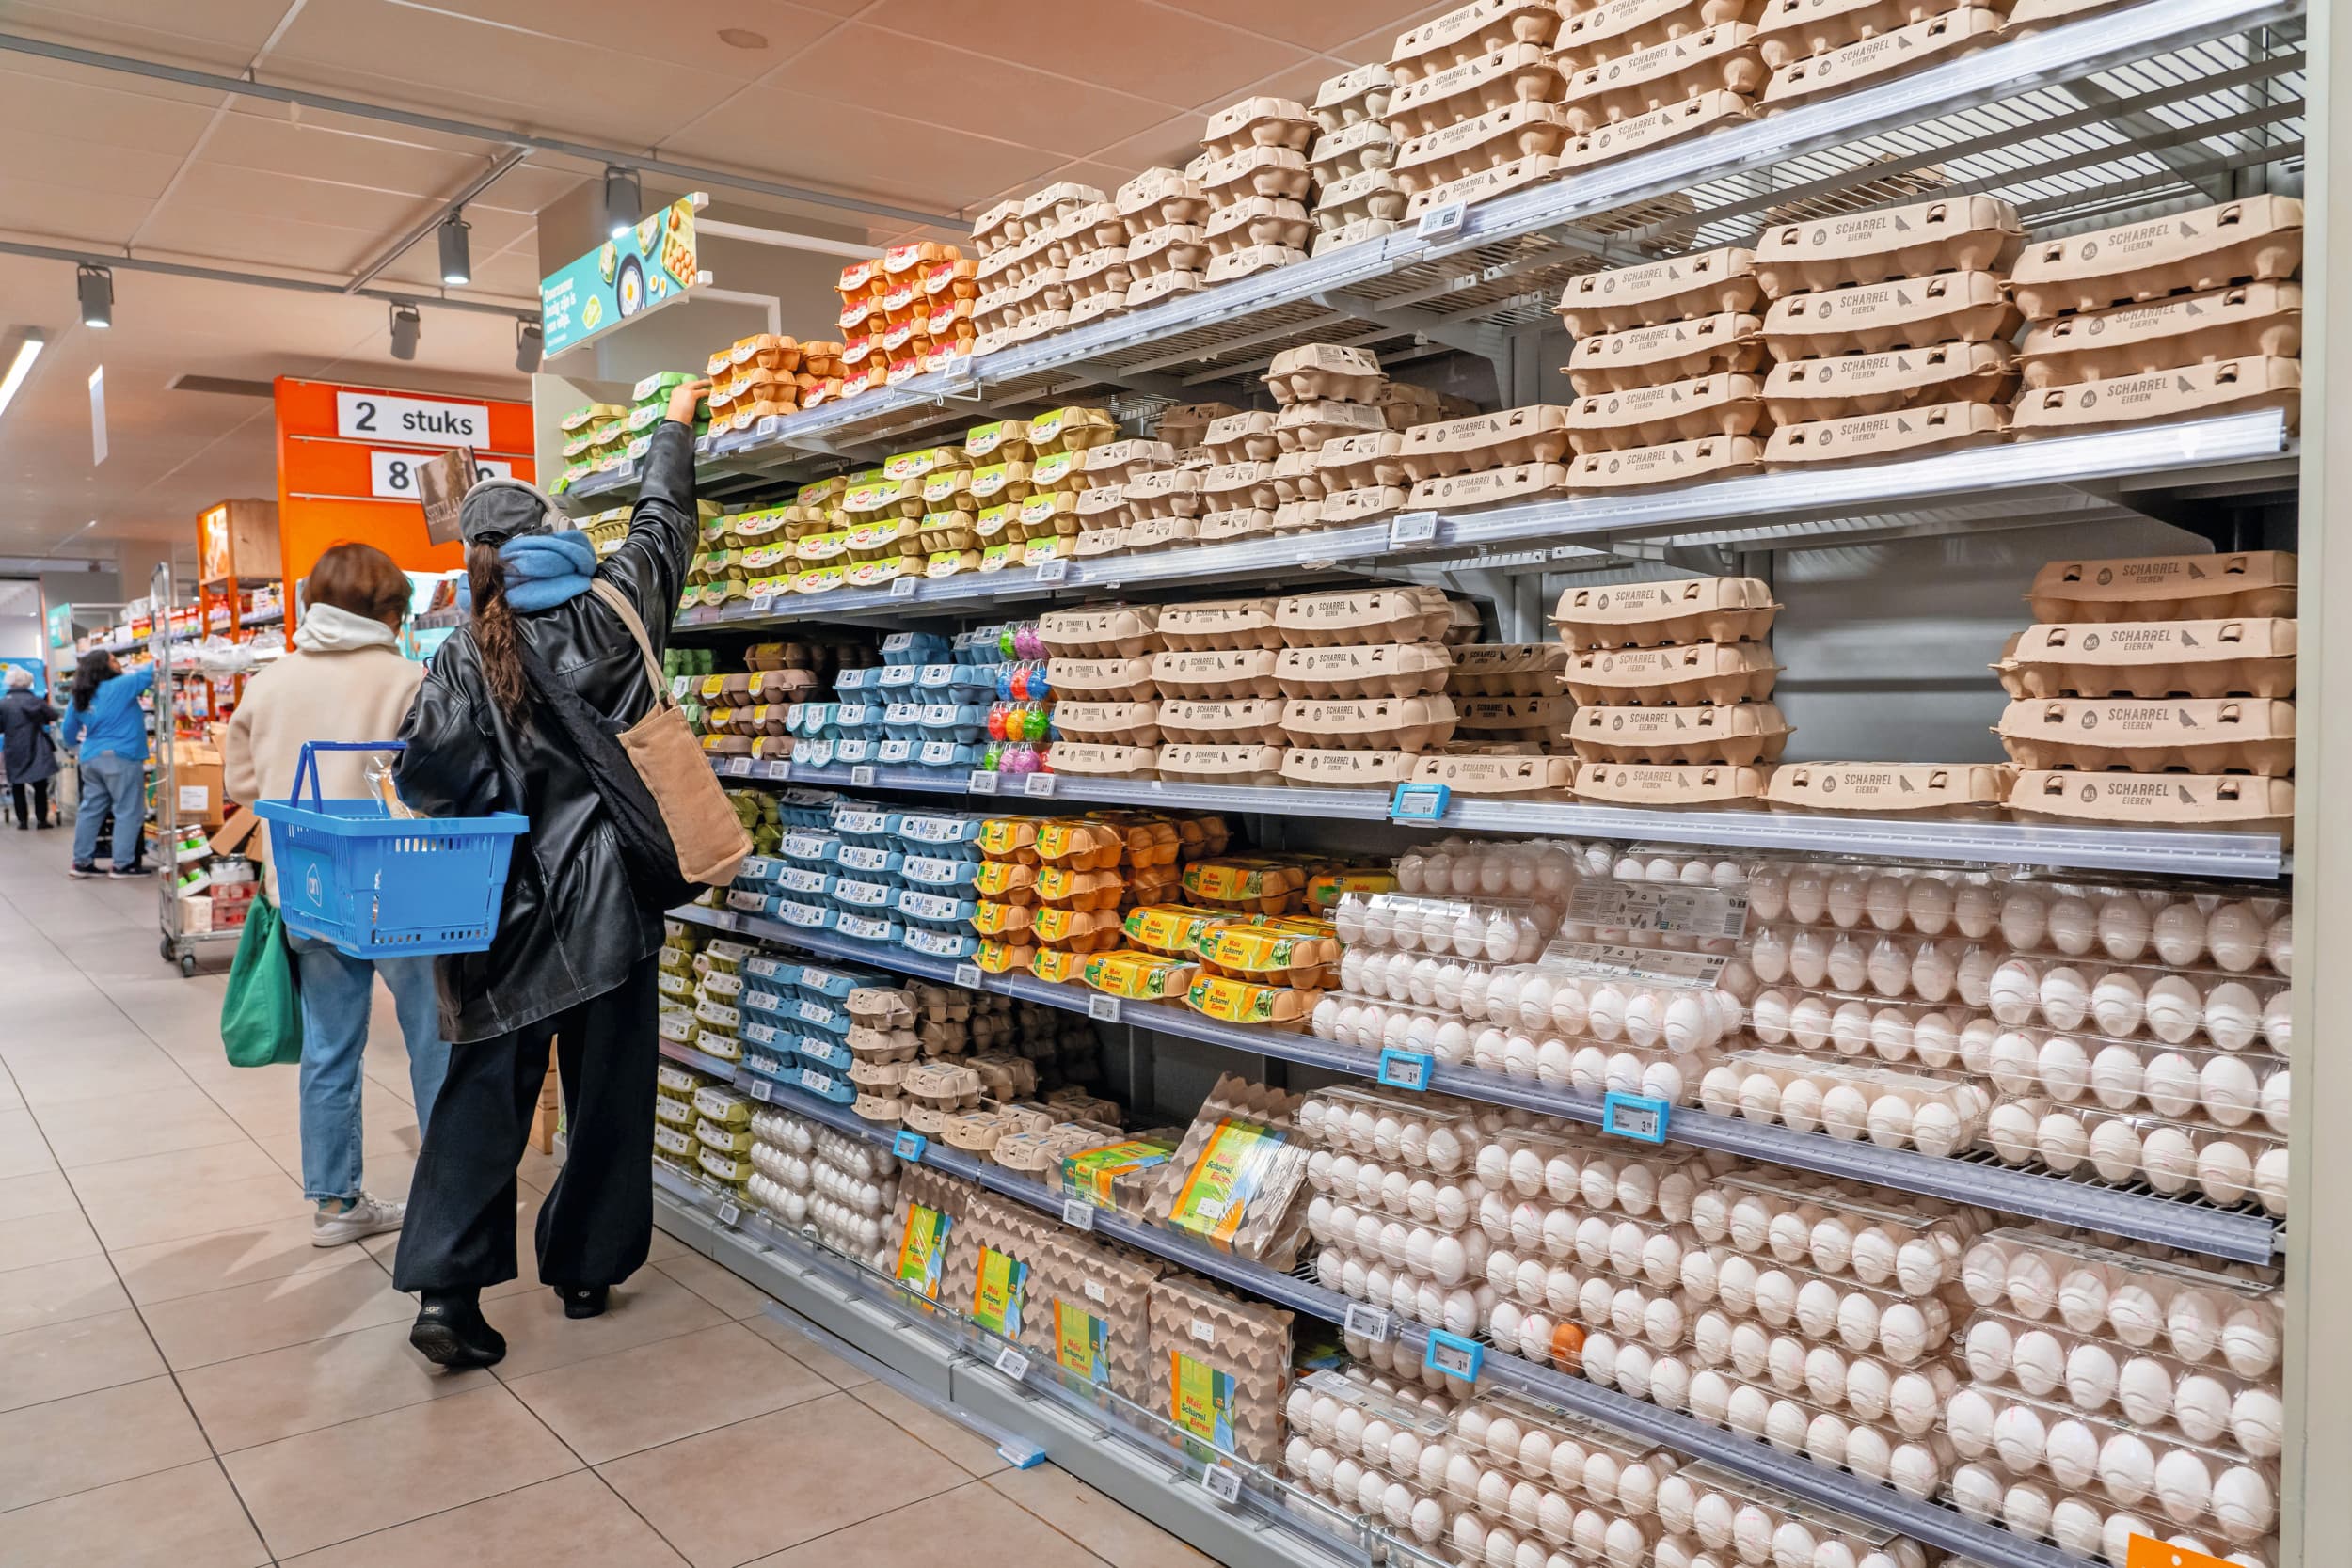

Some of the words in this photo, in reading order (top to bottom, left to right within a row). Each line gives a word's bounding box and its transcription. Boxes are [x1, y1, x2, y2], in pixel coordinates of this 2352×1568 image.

[1438, 9, 1470, 30] SCHARREL
[1840, 39, 1890, 63] SCHARREL
[1629, 48, 1668, 69] SCHARREL
[1851, 54, 1877, 67] EIEREN
[1435, 65, 1468, 86] SCHARREL
[1442, 122, 1475, 141] SCHARREL
[1618, 117, 1657, 135] SCHARREL
[1453, 175, 1485, 193] SCHARREL
[1836, 217, 1887, 235] SCHARREL
[1848, 231, 1872, 242] EIEREN
[2108, 224, 2169, 246] SCHARREL
[2122, 240, 2153, 253] EIEREN
[1622, 267, 1663, 283] SCHARREL
[1840, 291, 1889, 308] SCHARREL
[1851, 305, 1876, 315] EIEREN
[2115, 304, 2176, 324] SCHARREL
[2129, 318, 2159, 329] EIEREN
[1629, 329, 1670, 344] SCHARREL
[1840, 357, 1890, 372] SCHARREL
[1851, 371, 1876, 380] EIEREN
[2107, 377, 2168, 397] SCHARREL
[1626, 389, 1665, 405] SCHARREL
[2122, 393, 2152, 404] EIEREN
[356, 402, 376, 432] 2
[402, 410, 473, 436] stuks
[1452, 421, 1486, 434] SCHARREL
[1840, 420, 1889, 436] SCHARREL
[1852, 433, 1876, 442] EIEREN
[1627, 451, 1667, 465] SCHARREL
[1457, 475, 1490, 488] SCHARREL
[2122, 562, 2180, 577] SCHARREL
[2136, 575, 2164, 584] EIEREN
[1615, 589, 1655, 601] SCHARREL
[1319, 602, 1346, 610] SCHARREL
[2110, 630, 2172, 642] SCHARREL
[2123, 642, 2153, 651] EIEREN
[1319, 654, 1347, 663] SCHARREL
[1619, 654, 1656, 665] SCHARREL
[1197, 705, 1221, 714] SCHARREL
[1326, 706, 1354, 715] SCHARREL
[2108, 708, 2169, 721] SCHARREL
[1630, 713, 1669, 724] SCHARREL
[2122, 721, 2153, 731] EIEREN
[1195, 751, 1219, 759] SCHARREL
[1323, 755, 1350, 765] SCHARREL
[1460, 764, 1495, 773] SCHARREL
[1633, 770, 1672, 783] SCHARREL
[1844, 773, 1893, 785] SCHARREL
[1855, 785, 1879, 794] EIEREN
[2107, 783, 2169, 797] SCHARREL
[2122, 797, 2152, 806] EIEREN
[1068, 1338, 1081, 1352] Mais
[1186, 1395, 1202, 1410] Mais
[1182, 1402, 1206, 1421] Scharrel
[1190, 1417, 1211, 1433] Eieren
